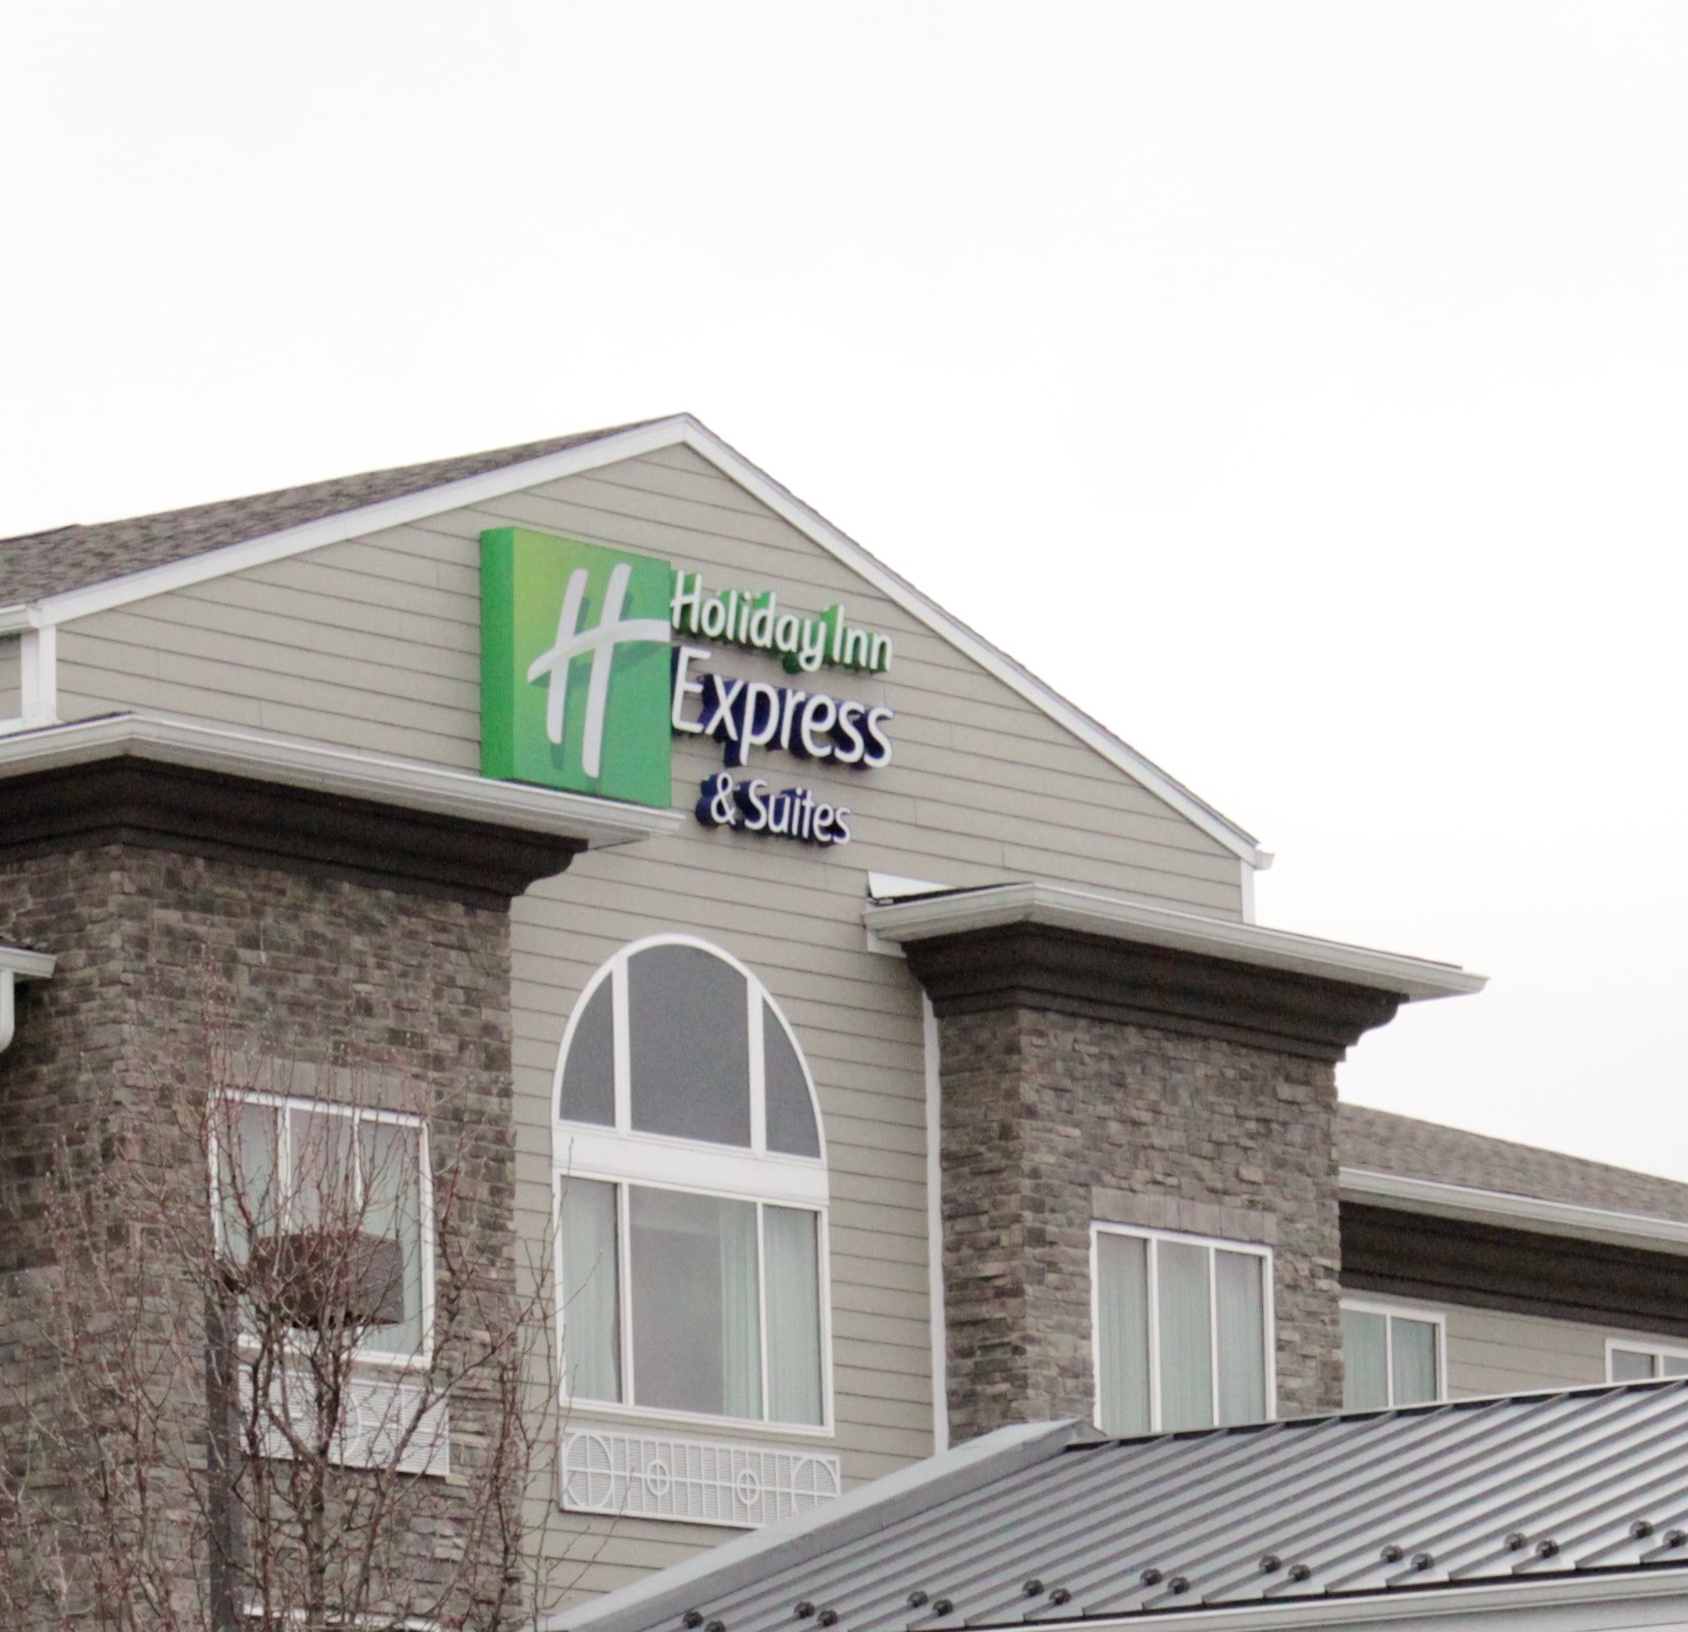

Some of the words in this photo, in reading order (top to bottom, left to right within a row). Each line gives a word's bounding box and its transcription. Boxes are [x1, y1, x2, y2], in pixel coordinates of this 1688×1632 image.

[528, 563, 671, 778] H
[671, 569, 827, 671] Holiday
[825, 605, 893, 672] Inn
[672, 647, 894, 768] Express
[711, 772, 739, 827] &
[745, 779, 852, 844] Suites
